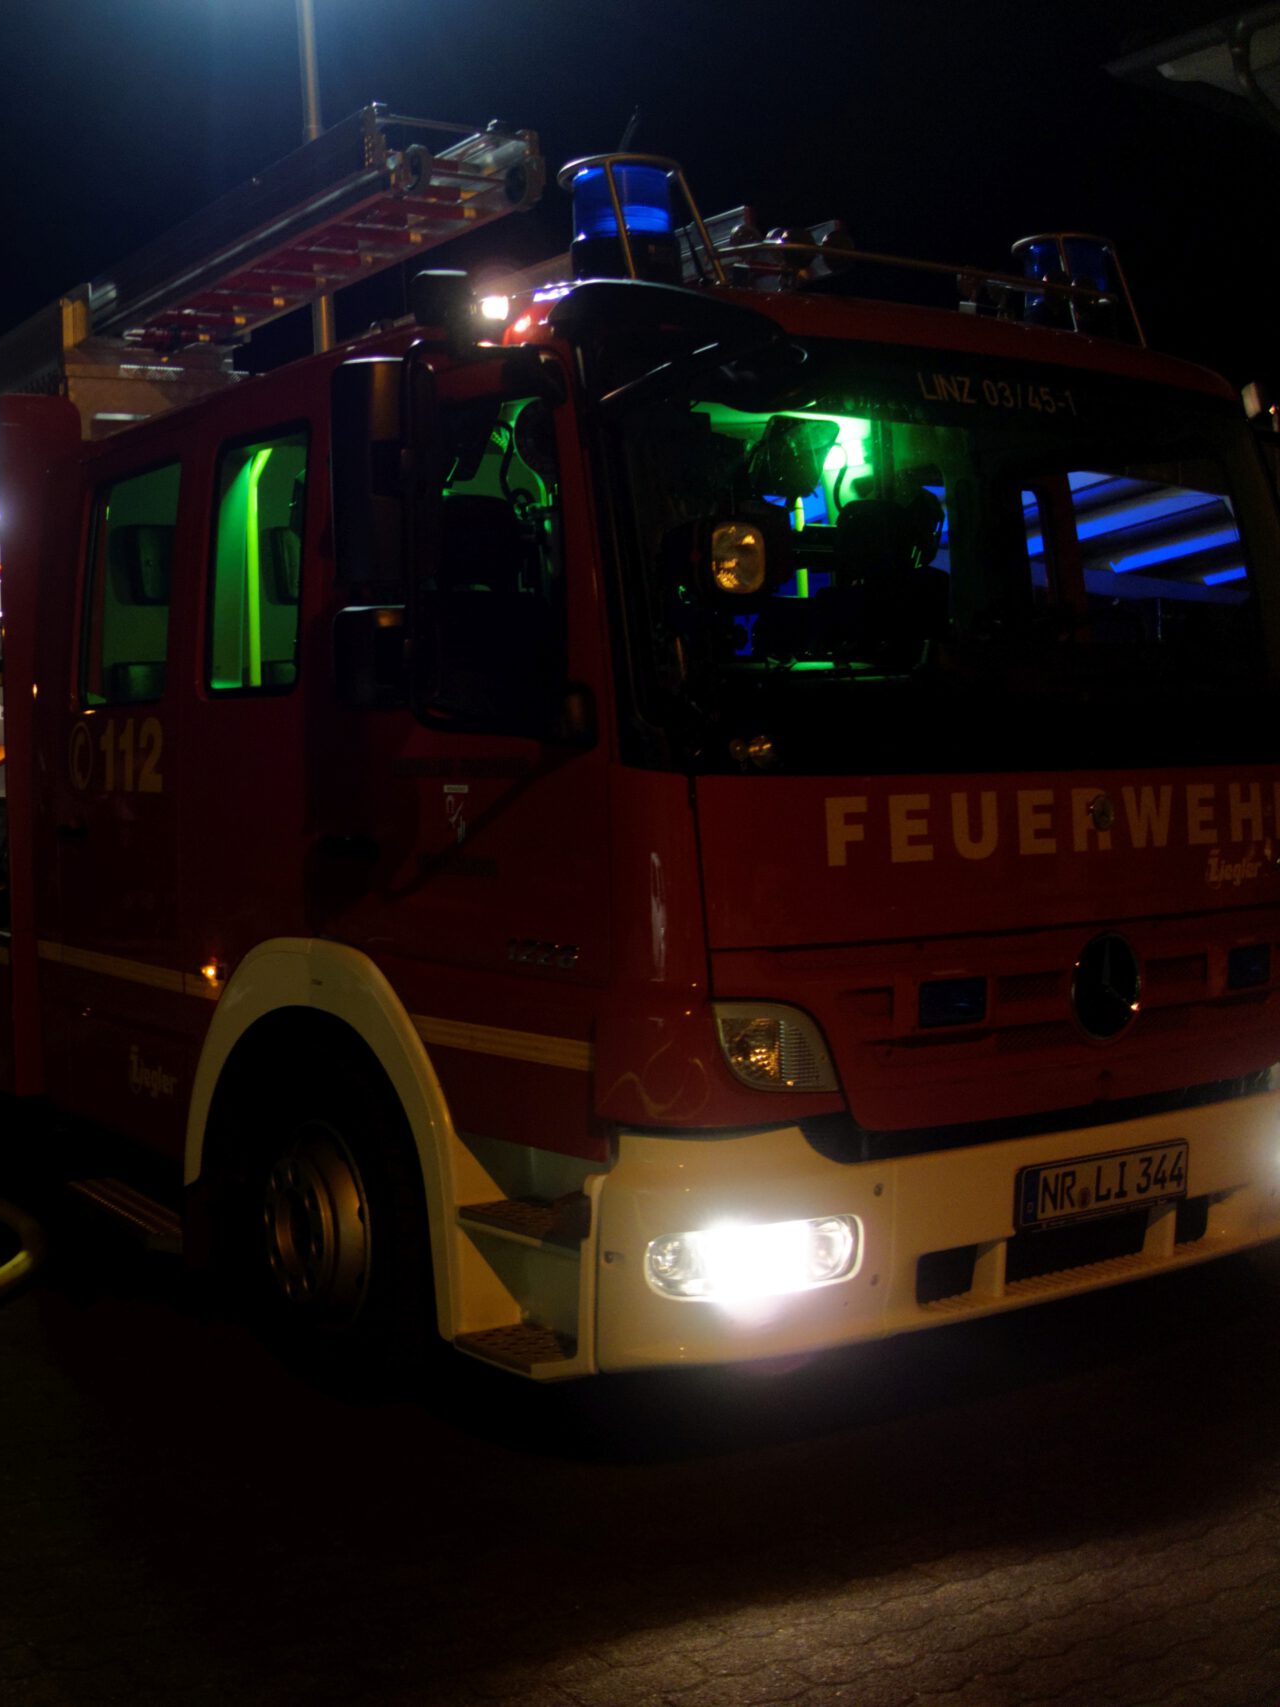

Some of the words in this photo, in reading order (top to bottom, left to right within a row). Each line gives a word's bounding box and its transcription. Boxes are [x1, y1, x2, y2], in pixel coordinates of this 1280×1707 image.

[916, 371, 977, 405] LINZ
[99, 716, 164, 792] 112
[1040, 1170, 1075, 1214] NR
[1094, 1160, 1127, 1202] LI
[1136, 1151, 1184, 1194] 344
